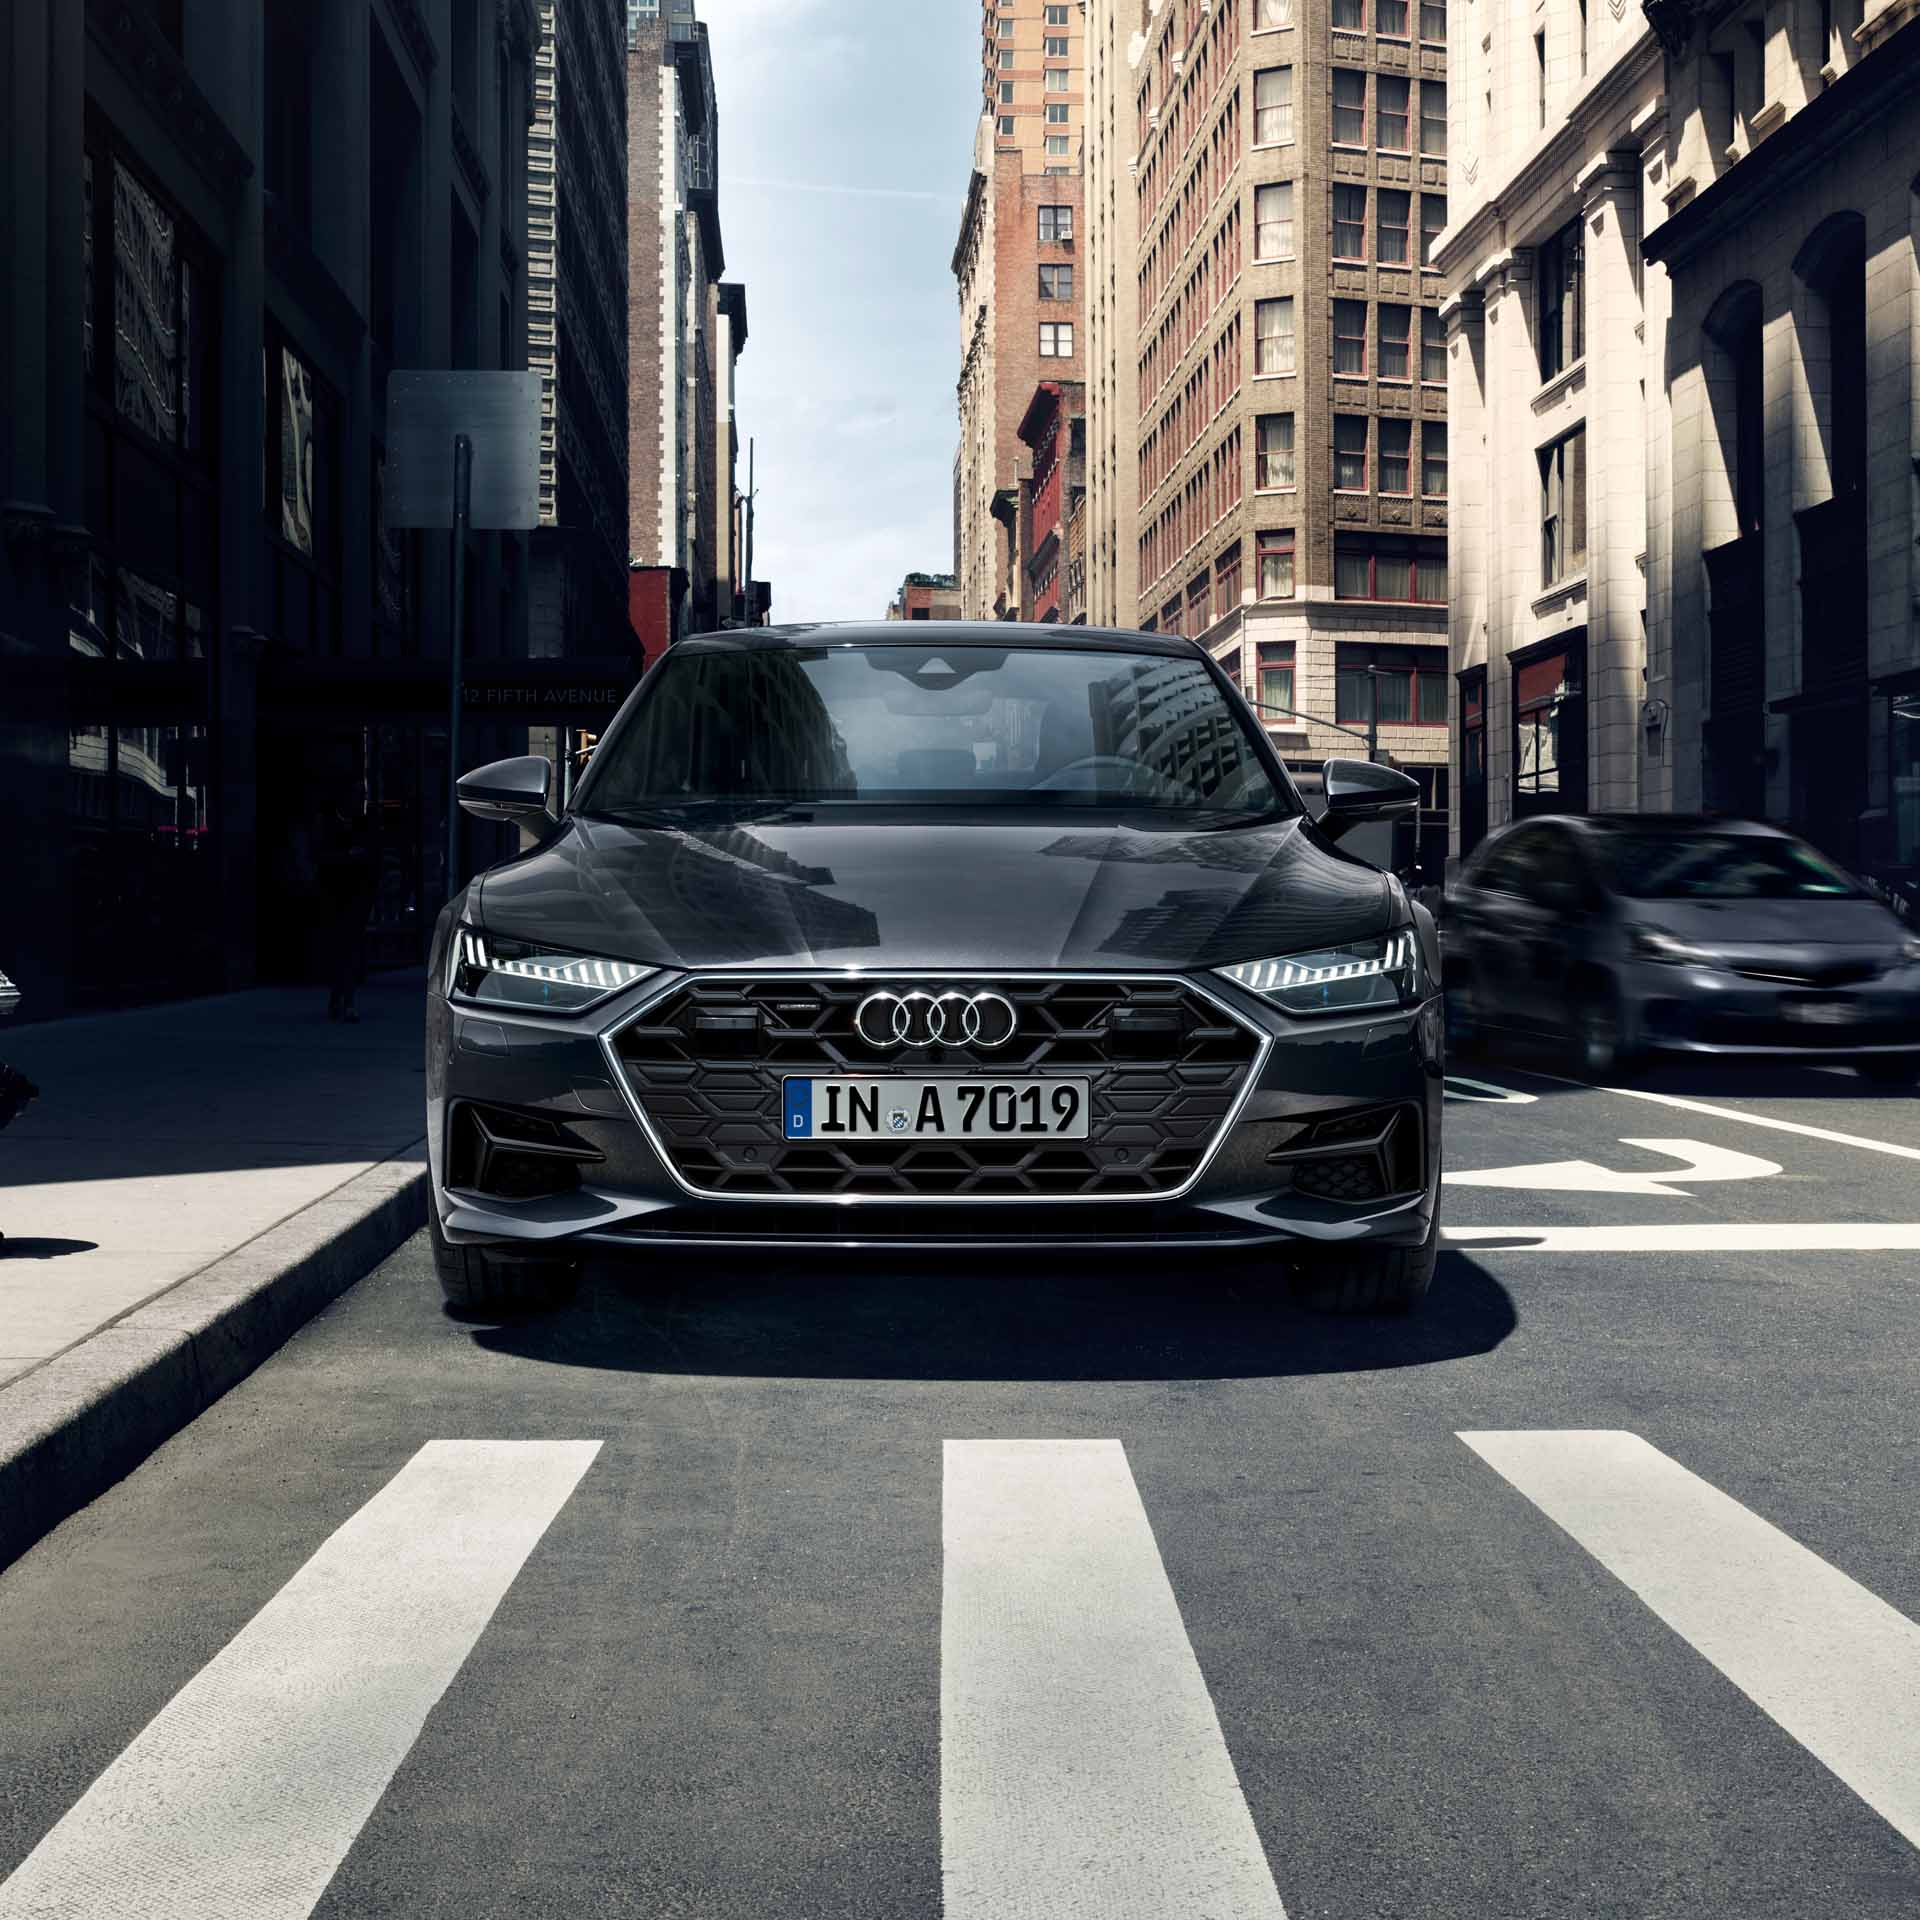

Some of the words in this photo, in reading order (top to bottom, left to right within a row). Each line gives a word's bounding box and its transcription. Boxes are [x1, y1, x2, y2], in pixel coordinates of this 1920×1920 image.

[487, 687, 537, 704] FIFTH
[544, 687, 617, 704] AVENUE
[792, 1114, 805, 1128] D
[821, 1084, 879, 1132] IN
[915, 1084, 945, 1132] A
[957, 1084, 1080, 1132] 7019
